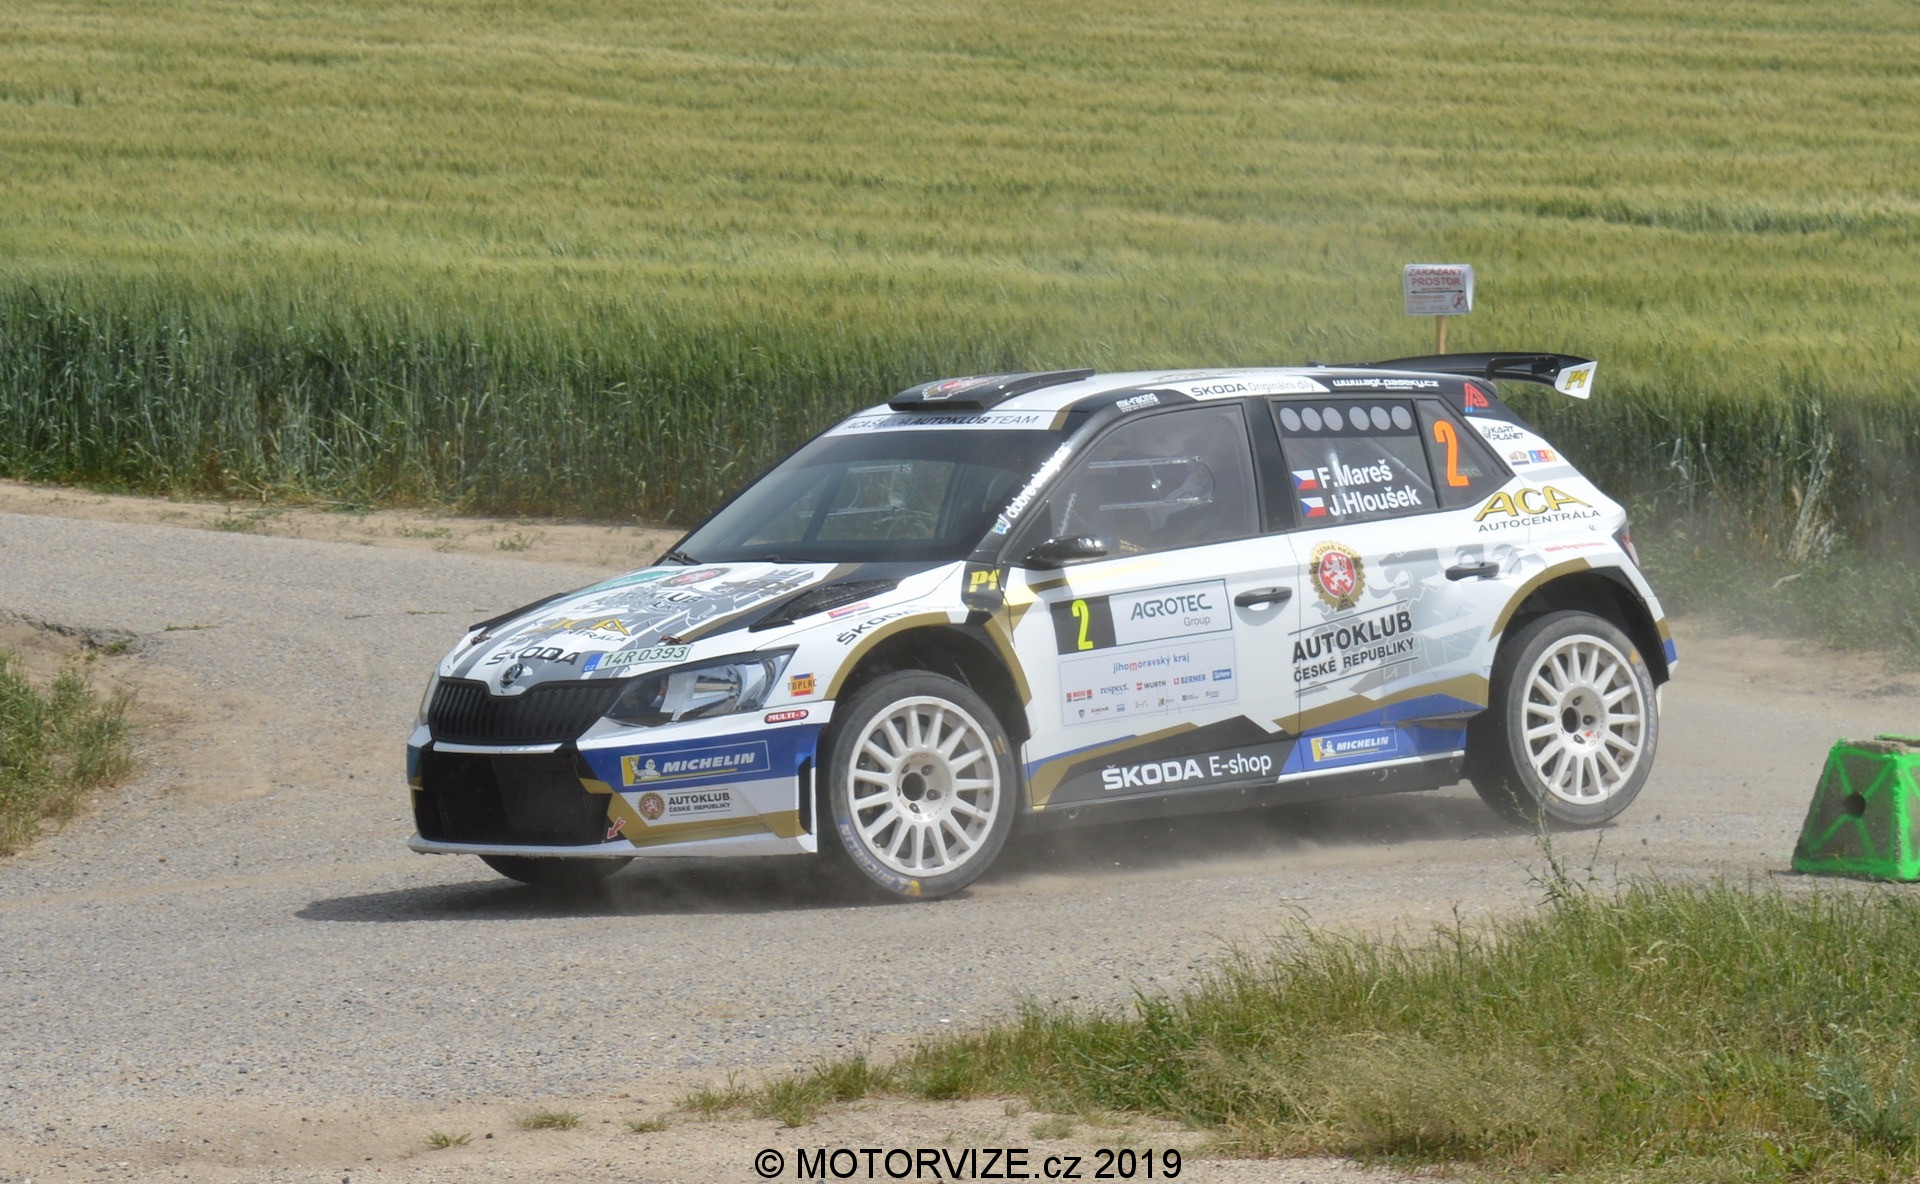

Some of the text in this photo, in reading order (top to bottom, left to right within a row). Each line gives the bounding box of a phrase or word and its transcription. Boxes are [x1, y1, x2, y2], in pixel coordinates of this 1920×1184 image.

[1411, 277, 1460, 286] PROSTOR
[1191, 383, 1248, 397] ŠKODA
[911, 415, 990, 426] AUTOKLUB
[991, 415, 1039, 425] TEAM
[1432, 419, 1470, 487] 2
[1316, 459, 1393, 489] F.Mareš
[1329, 485, 1422, 517] J.Hloušek
[1473, 485, 1594, 522] ACA
[1478, 510, 1602, 532] AUTOCENTRÁLA
[968, 569, 1000, 593] P1
[1130, 593, 1213, 621] AGROTEC
[1071, 599, 1094, 650] 2
[1183, 615, 1211, 627] Group
[1292, 610, 1413, 664] AUTOKLUB
[604, 651, 637, 666] 14R
[637, 646, 688, 661] 0393
[1112, 651, 1190, 674] jihomoravský kraj
[1293, 637, 1415, 683] ČESKÉ REPUBLIKY
[1180, 674, 1206, 684] BERNER
[1336, 735, 1389, 750] MICHELIN
[662, 752, 756, 774] MICHELIN
[1101, 752, 1272, 790] ŠKODA E-shop
[668, 792, 730, 806] AUTOKLUB
[668, 801, 731, 813] ČESKÉ REPUBLIKY
